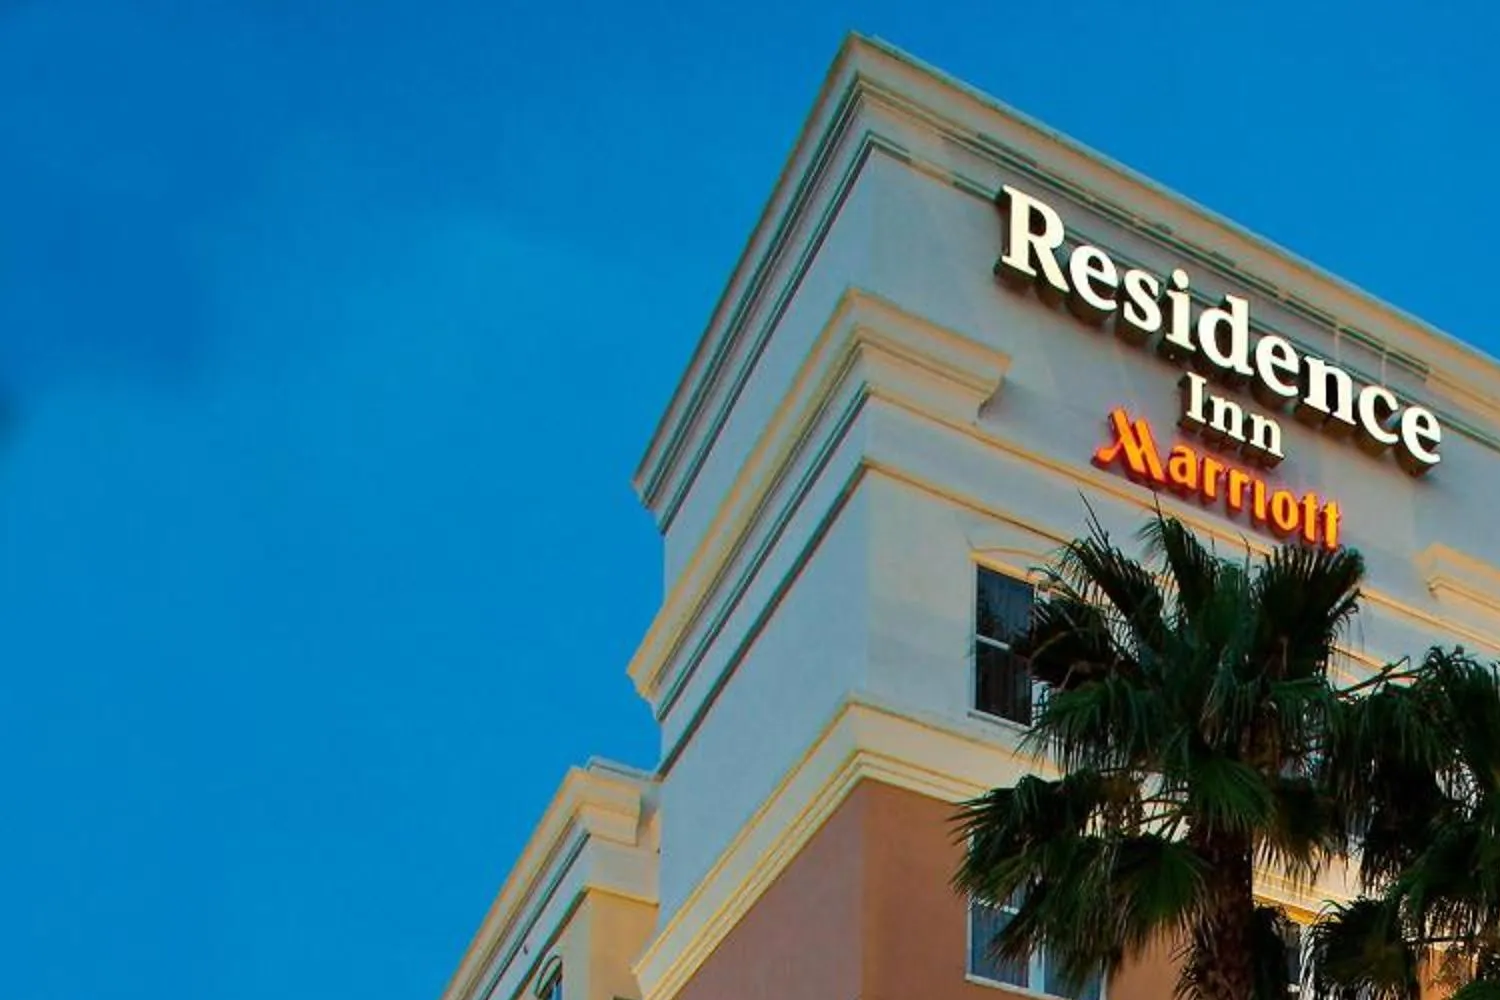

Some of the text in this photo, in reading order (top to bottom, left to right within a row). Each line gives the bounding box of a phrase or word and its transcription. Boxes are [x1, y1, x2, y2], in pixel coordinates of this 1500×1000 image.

[1001, 183, 1440, 464] Residence
[1094, 406, 1342, 549] Marriott
[1185, 371, 1284, 458] Inn
